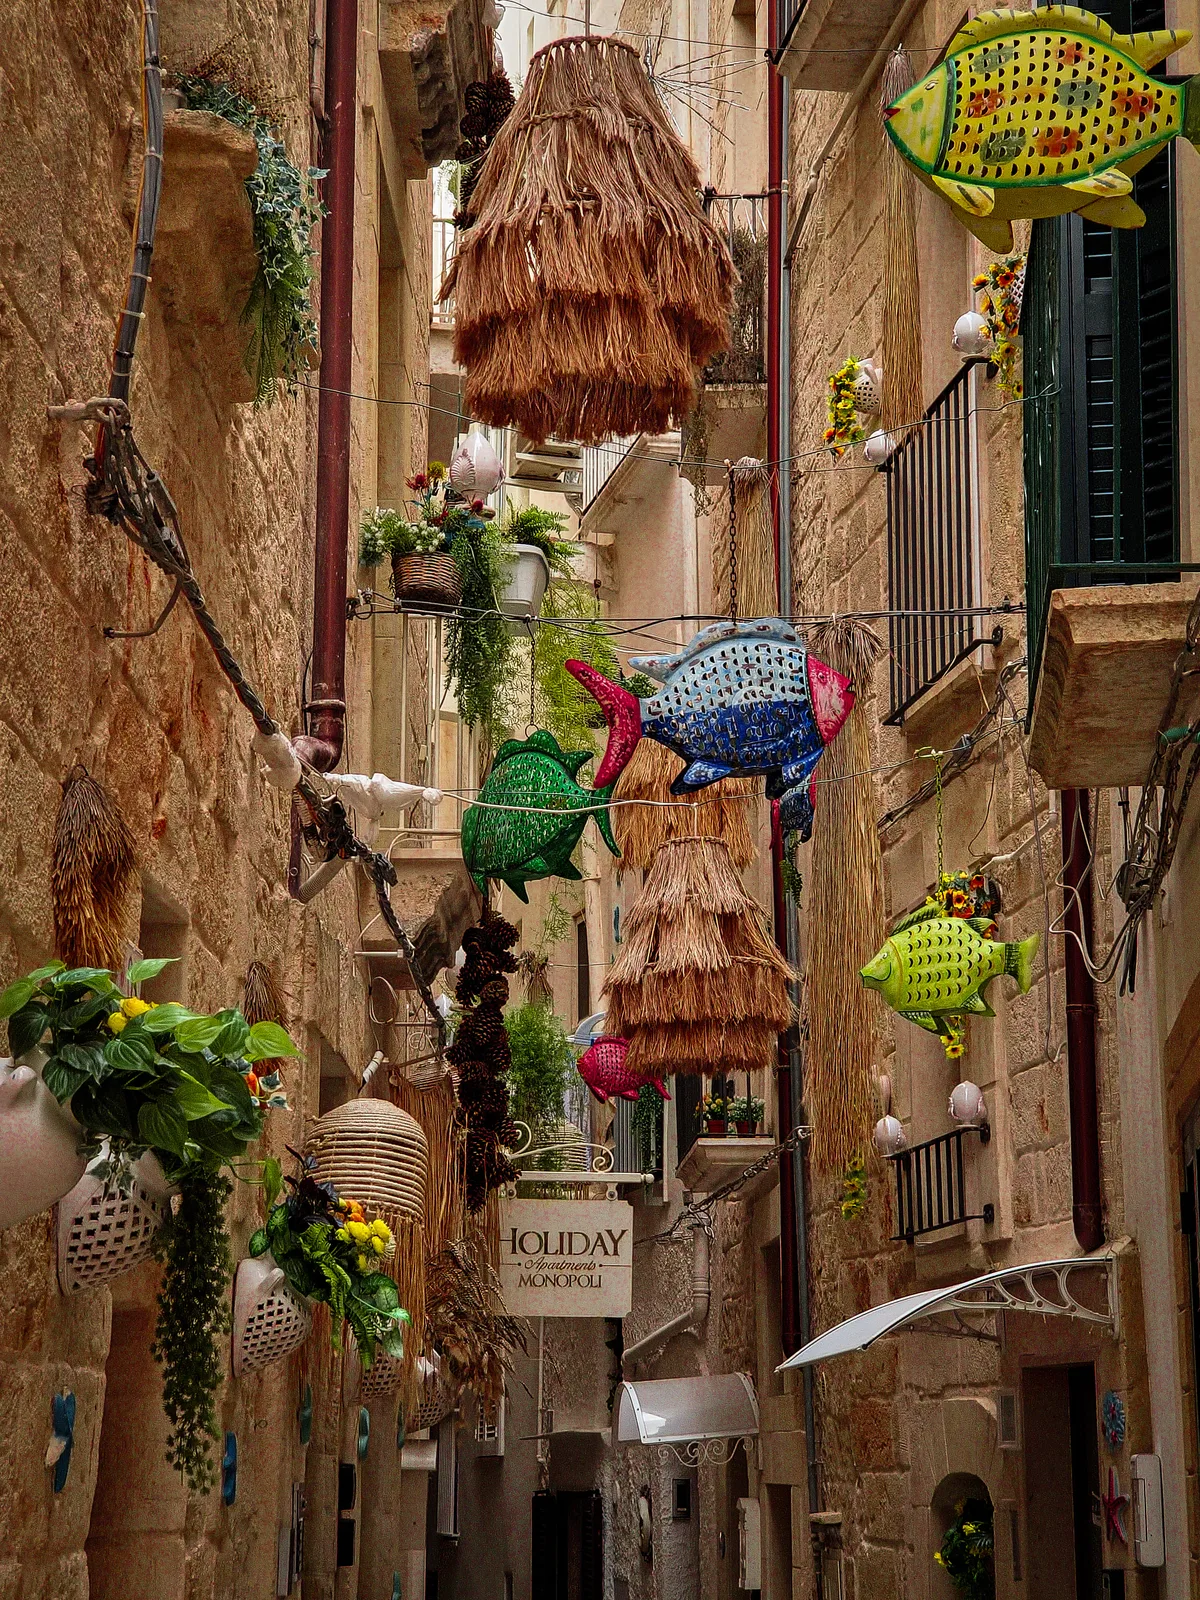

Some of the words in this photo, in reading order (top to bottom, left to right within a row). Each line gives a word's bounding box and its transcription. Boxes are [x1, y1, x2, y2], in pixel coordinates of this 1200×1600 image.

[500, 1228, 629, 1256] HOLIDAY
[525, 1256, 597, 1273] Apartments
[518, 1274, 603, 1288] MONOPOLI
